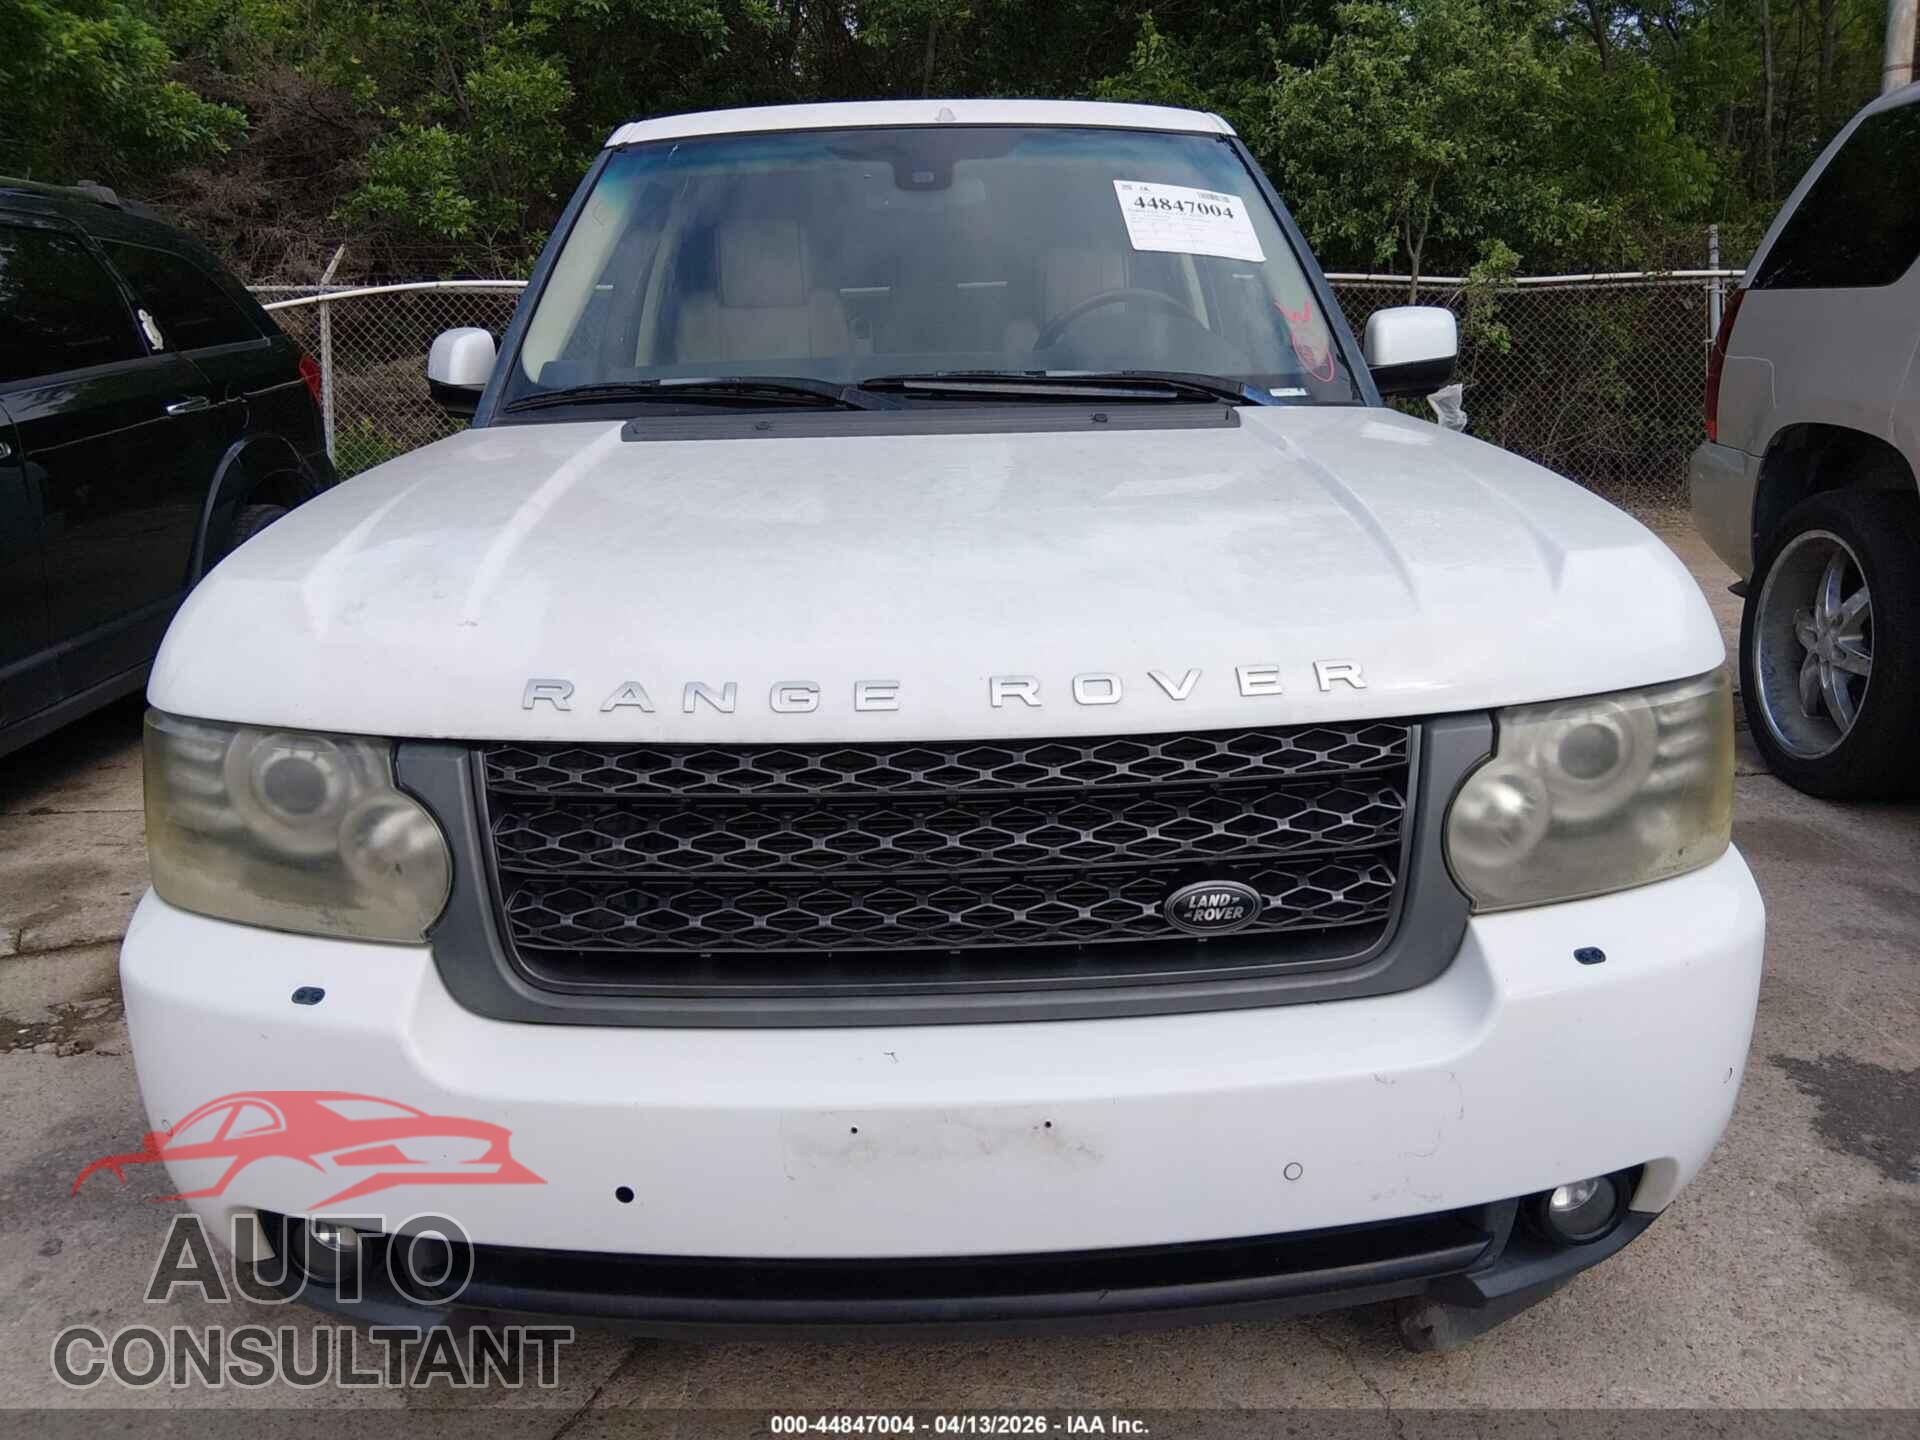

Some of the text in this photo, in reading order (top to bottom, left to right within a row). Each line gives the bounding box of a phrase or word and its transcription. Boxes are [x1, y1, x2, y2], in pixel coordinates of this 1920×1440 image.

[1133, 196, 1234, 219] 44847004
[522, 659, 1367, 713] RANGE ROVER
